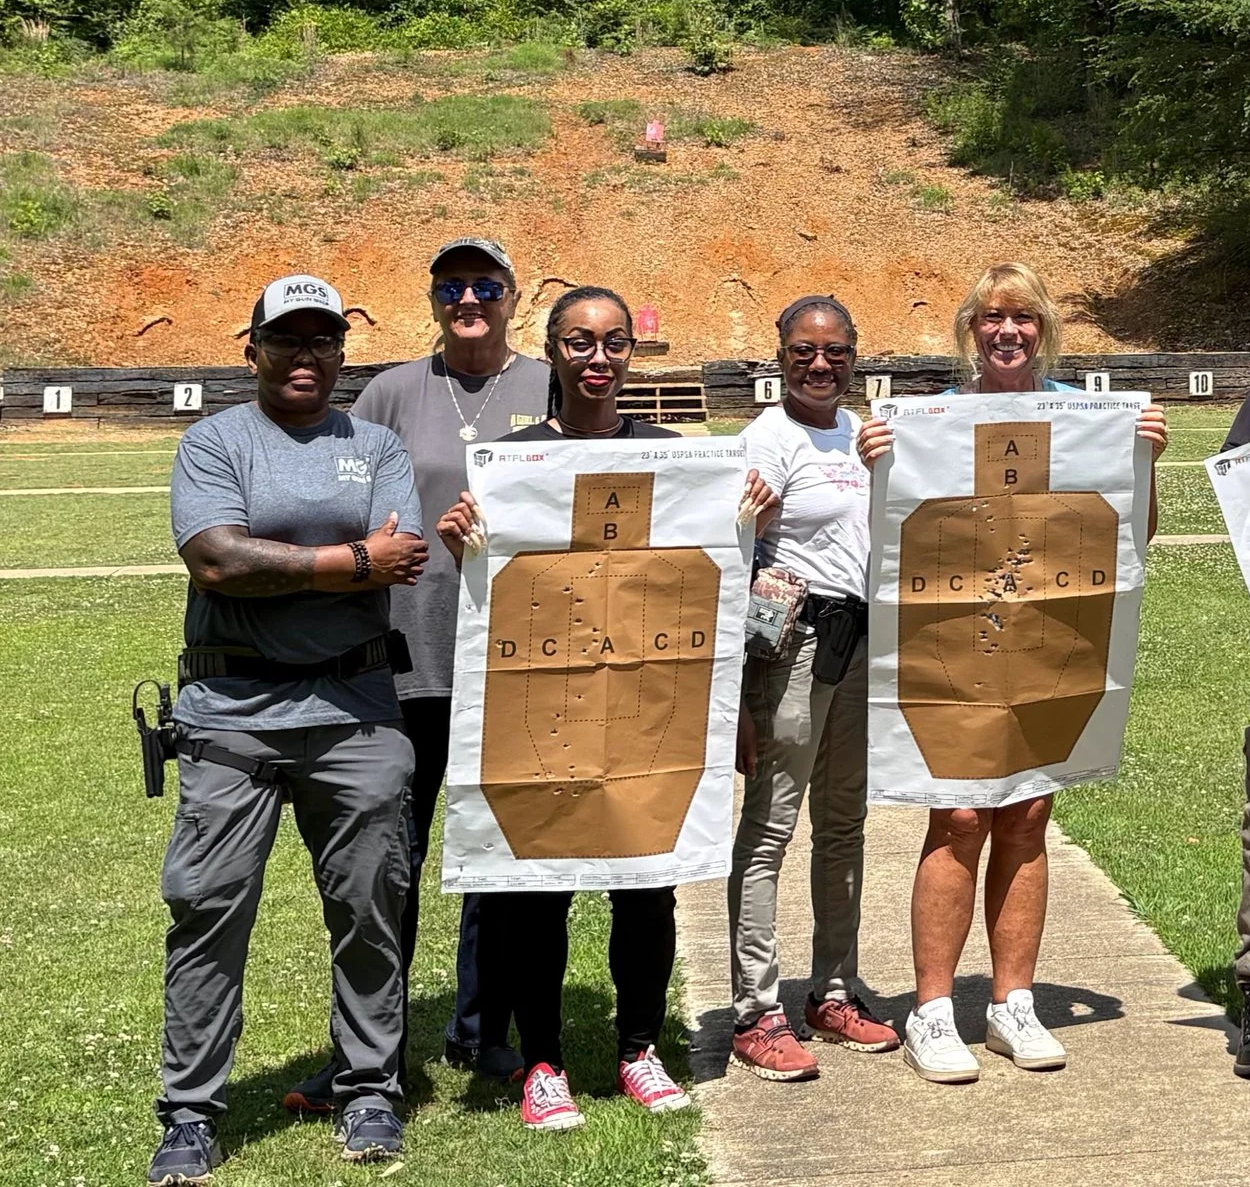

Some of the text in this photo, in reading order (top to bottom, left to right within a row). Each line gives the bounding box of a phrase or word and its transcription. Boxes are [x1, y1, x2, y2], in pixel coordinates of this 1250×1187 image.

[286, 283, 327, 298] MGS
[764, 380, 772, 400] 6
[875, 379, 883, 397] 7
[1094, 375, 1102, 392] 9
[1193, 374, 1208, 393] 10
[54, 389, 61, 410] 1
[184, 387, 192, 407] 2
[1089, 401, 1120, 410] PRACTICE
[694, 449, 724, 459] PRACTICE
[1004, 440, 1019, 456] A
[1005, 469, 1018, 485] B
[605, 491, 621, 509] A
[603, 523, 618, 540] B
[911, 576, 926, 593] D
[949, 575, 963, 592] C
[1055, 571, 1069, 588] C
[1092, 570, 1106, 586] D
[501, 631, 705, 658] D C A C D
